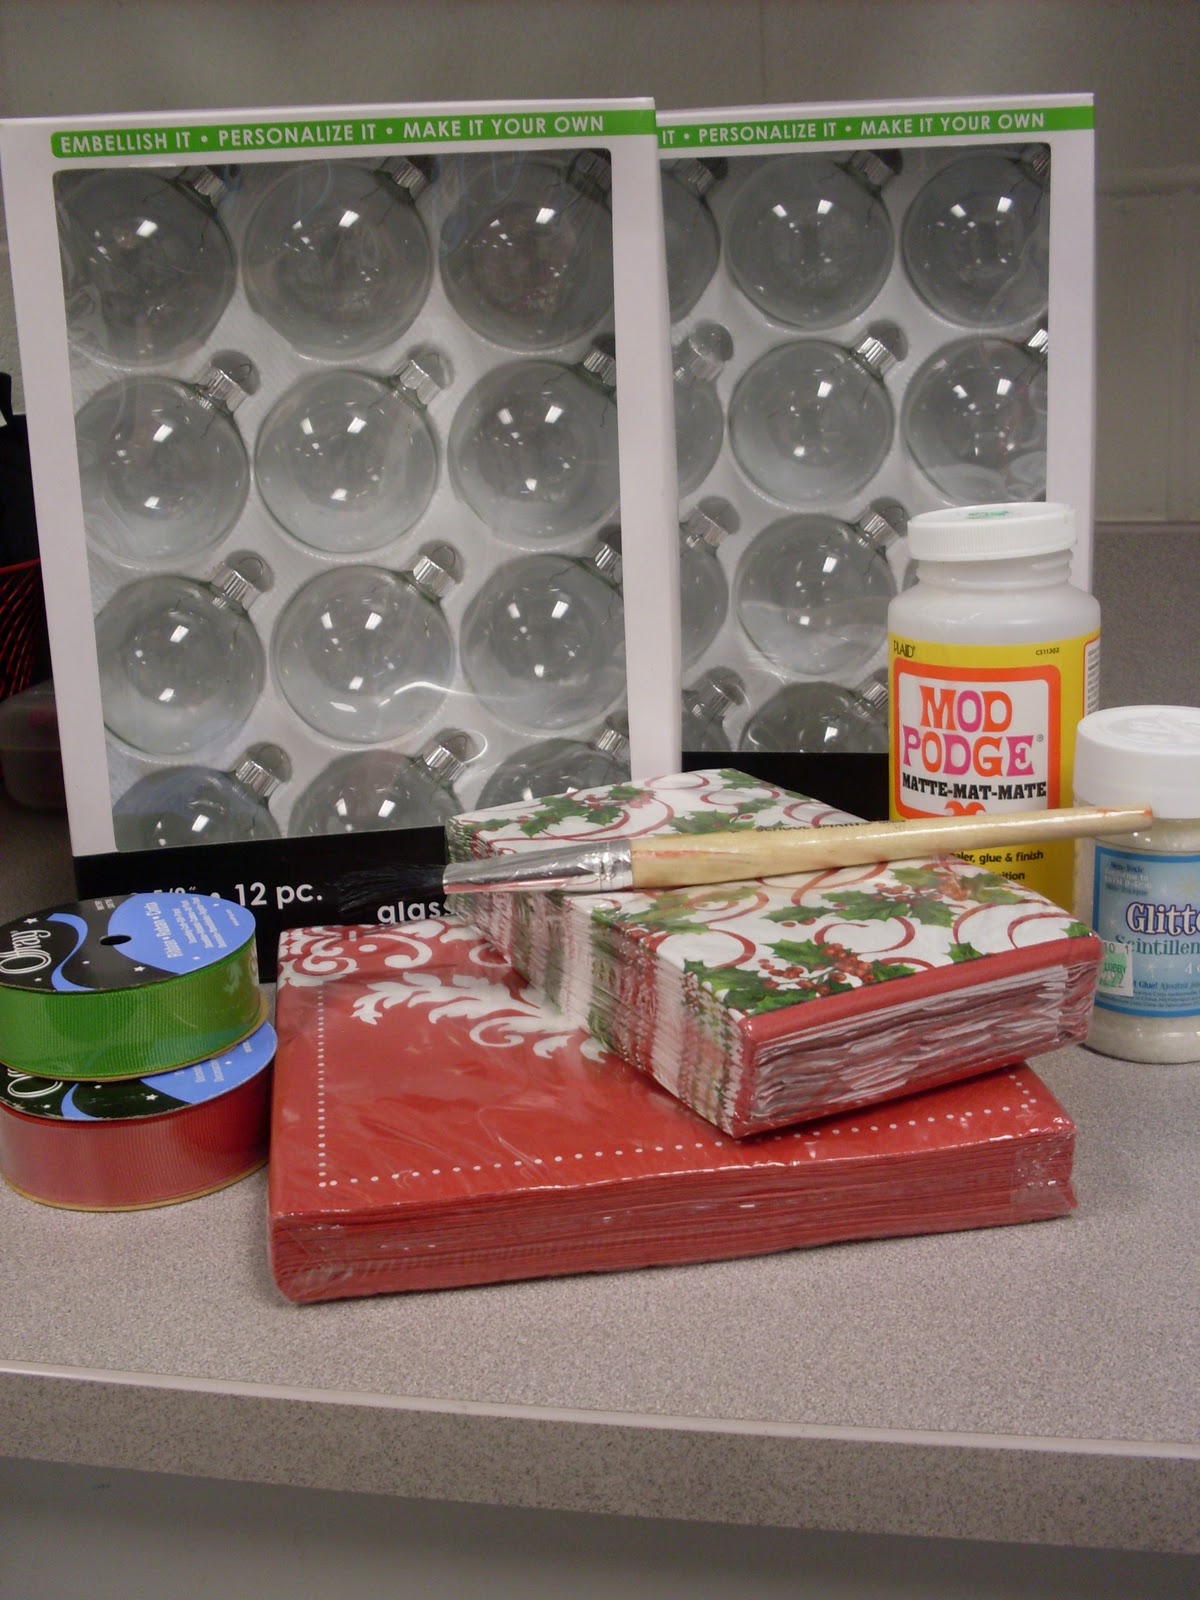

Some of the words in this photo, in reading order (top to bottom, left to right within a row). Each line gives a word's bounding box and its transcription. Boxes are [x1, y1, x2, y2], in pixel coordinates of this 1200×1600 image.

[60, 133, 168, 154] EMBELLISH
[176, 131, 191, 149] IT
[218, 125, 354, 147] PERSONALIZE
[361, 124, 376, 141] IT
[403, 120, 461, 139] MAKE
[469, 119, 484, 136] IT
[491, 117, 547, 135] YOUR
[554, 115, 604, 133] OWN
[662, 130, 675, 145] IT
[699, 123, 817, 143] PERSONALIZE
[823, 122, 836, 137] IT
[860, 118, 913, 136] MAKE
[920, 117, 933, 133] IT
[940, 115, 990, 131] YOUR
[998, 113, 1044, 129] OWN
[893, 640, 913, 658] PLAID
[919, 685, 1013, 733] MOD
[902, 725, 1035, 777] PODGE
[902, 772, 1047, 800] MATTE-MAT-MATE
[979, 853, 1002, 865] glue
[1005, 853, 1013, 862] &
[1016, 850, 1044, 861] finish
[234, 882, 268, 907] 12
[276, 883, 323, 910] pc.
